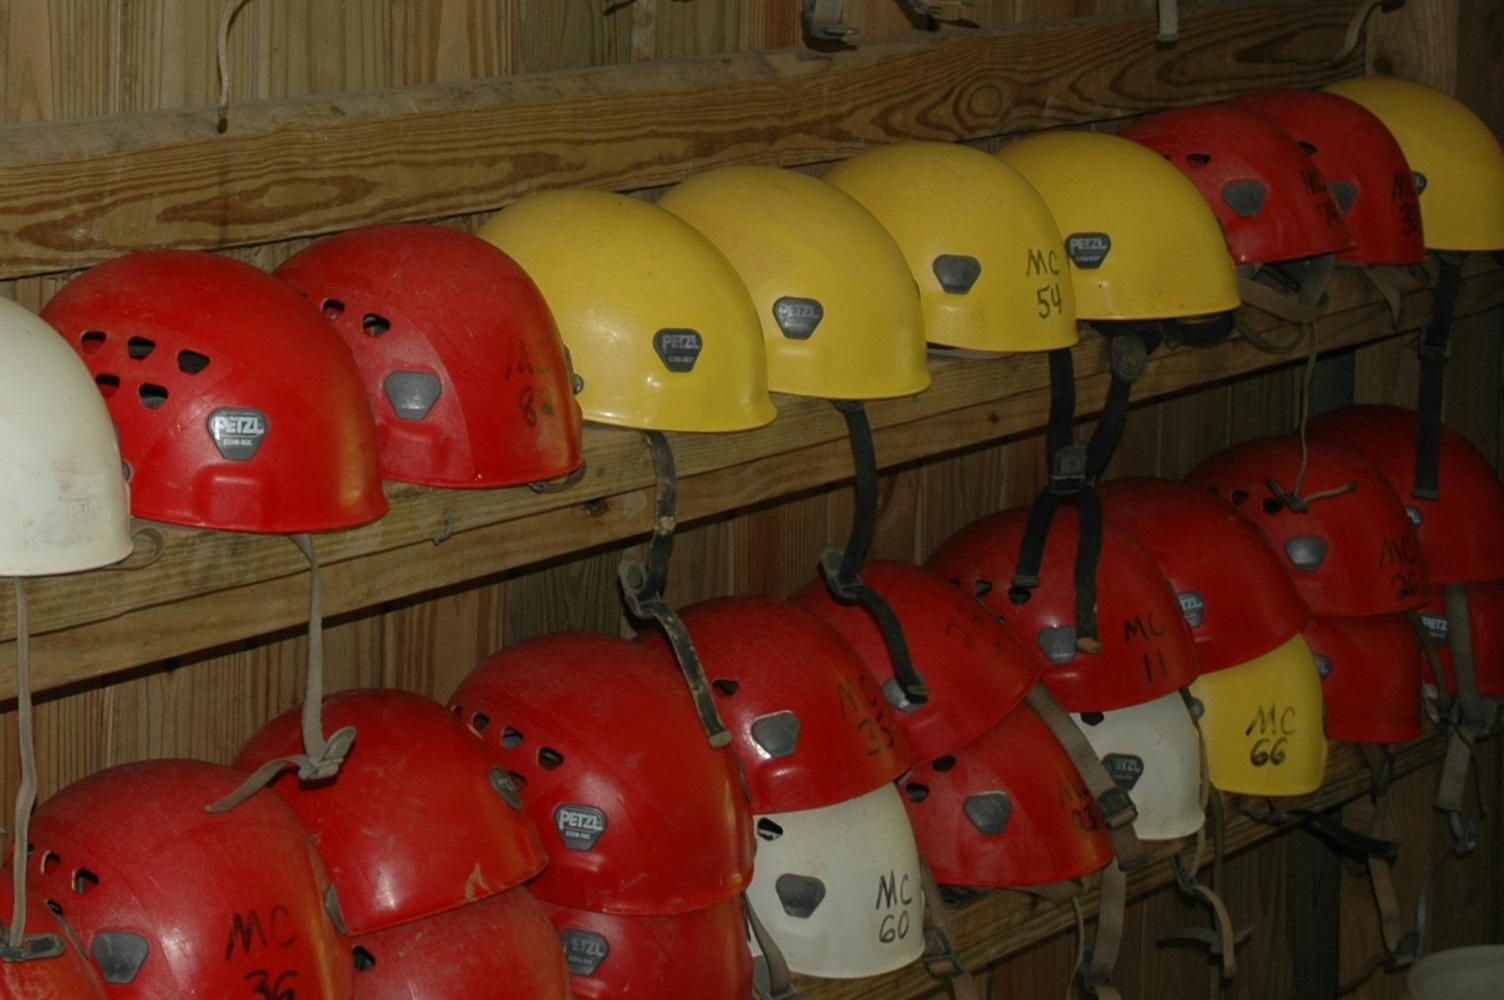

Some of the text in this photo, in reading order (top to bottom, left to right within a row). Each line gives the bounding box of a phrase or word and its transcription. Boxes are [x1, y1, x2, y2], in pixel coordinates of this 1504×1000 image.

[1070, 237, 1107, 255] PETZL
[1026, 248, 1060, 278] MC
[1037, 284, 1063, 320] 54
[662, 334, 699, 353] PETZL
[214, 416, 264, 441] PETZL
[1122, 611, 1166, 644] MC
[1422, 615, 1448, 632] PETZ
[1141, 650, 1166, 683] 11
[1245, 704, 1295, 736] MC
[1250, 738, 1286, 767] 66
[560, 809, 604, 831] PETZL
[876, 874, 912, 910] MC
[225, 906, 297, 962] MC
[879, 913, 910, 943] 60
